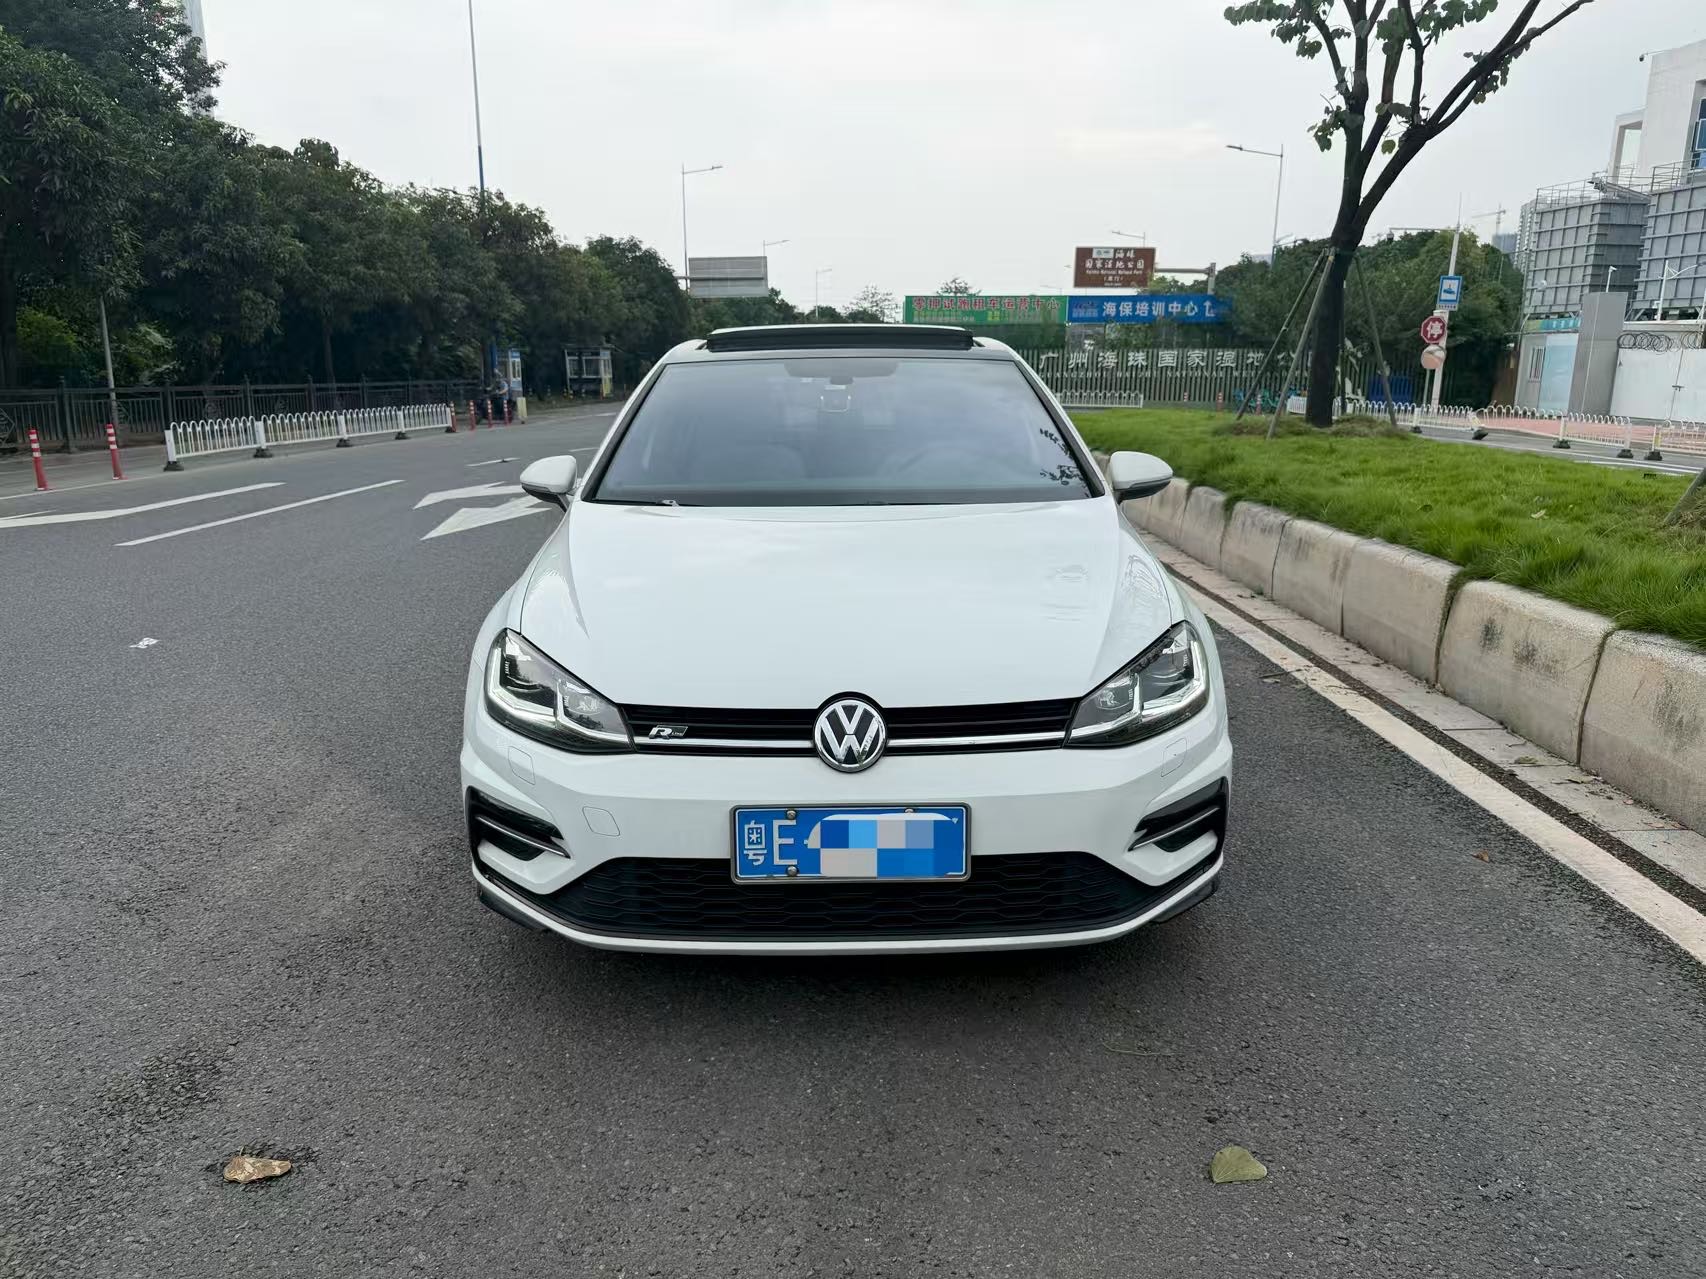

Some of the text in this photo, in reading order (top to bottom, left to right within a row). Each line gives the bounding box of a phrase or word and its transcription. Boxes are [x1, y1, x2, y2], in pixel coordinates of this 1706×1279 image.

[1102, 301, 1198, 317] 海保培训中心
[1427, 321, 1443, 339] 停
[1039, 351, 1313, 369] 广州海珠国家湿地公
